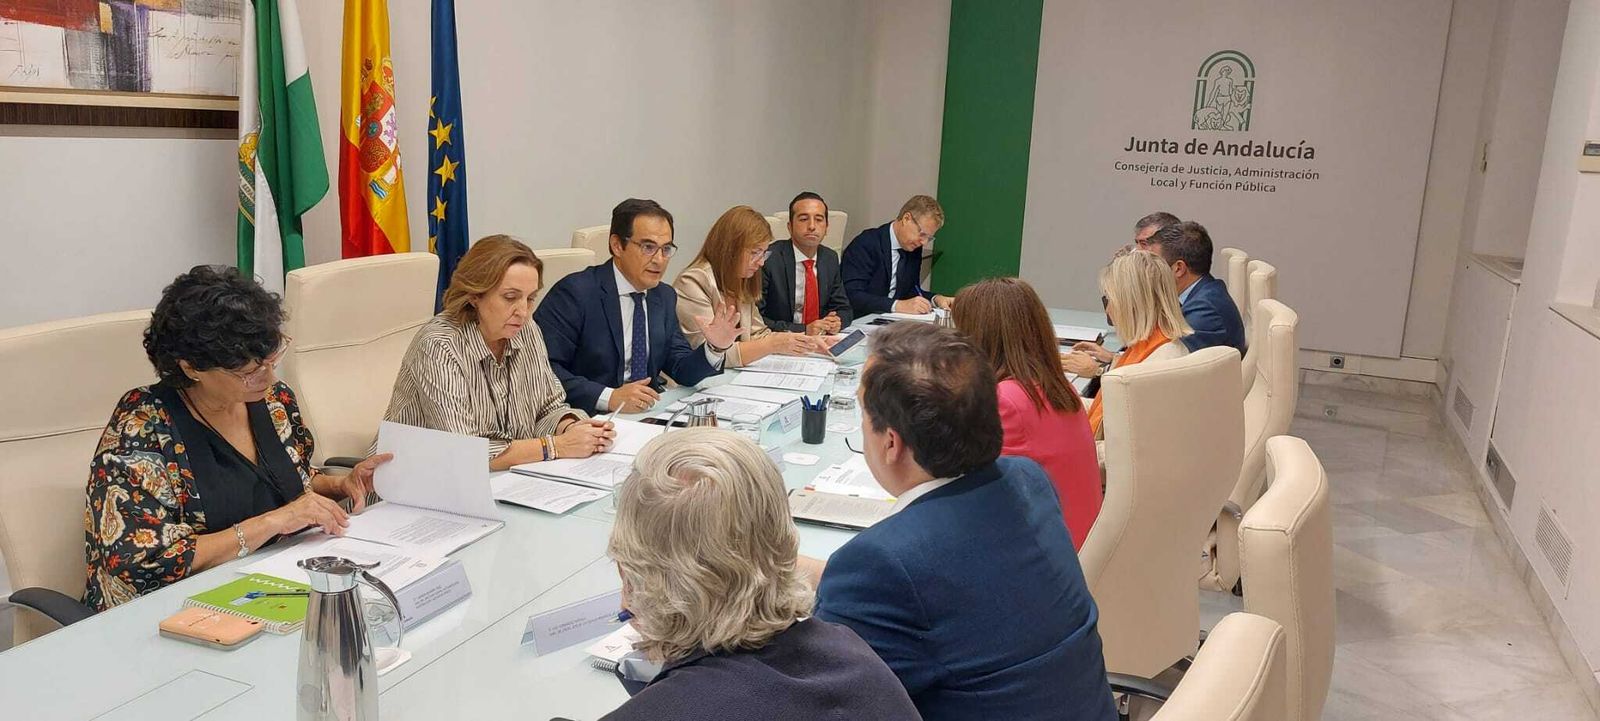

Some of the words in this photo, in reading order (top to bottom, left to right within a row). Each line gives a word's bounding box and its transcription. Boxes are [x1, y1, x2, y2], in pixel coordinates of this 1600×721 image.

[1124, 136, 1179, 154] Junta
[1184, 138, 1209, 155] de
[1212, 140, 1315, 160] Andalucía
[1114, 161, 1169, 174] Consejería
[1171, 164, 1185, 174] de
[1187, 165, 1232, 177] Justicia,
[1234, 167, 1320, 180] Administración
[1150, 178, 1179, 188] Local
[1180, 181, 1187, 190] y
[1189, 179, 1232, 191] Función
[1235, 181, 1277, 193] Pública
